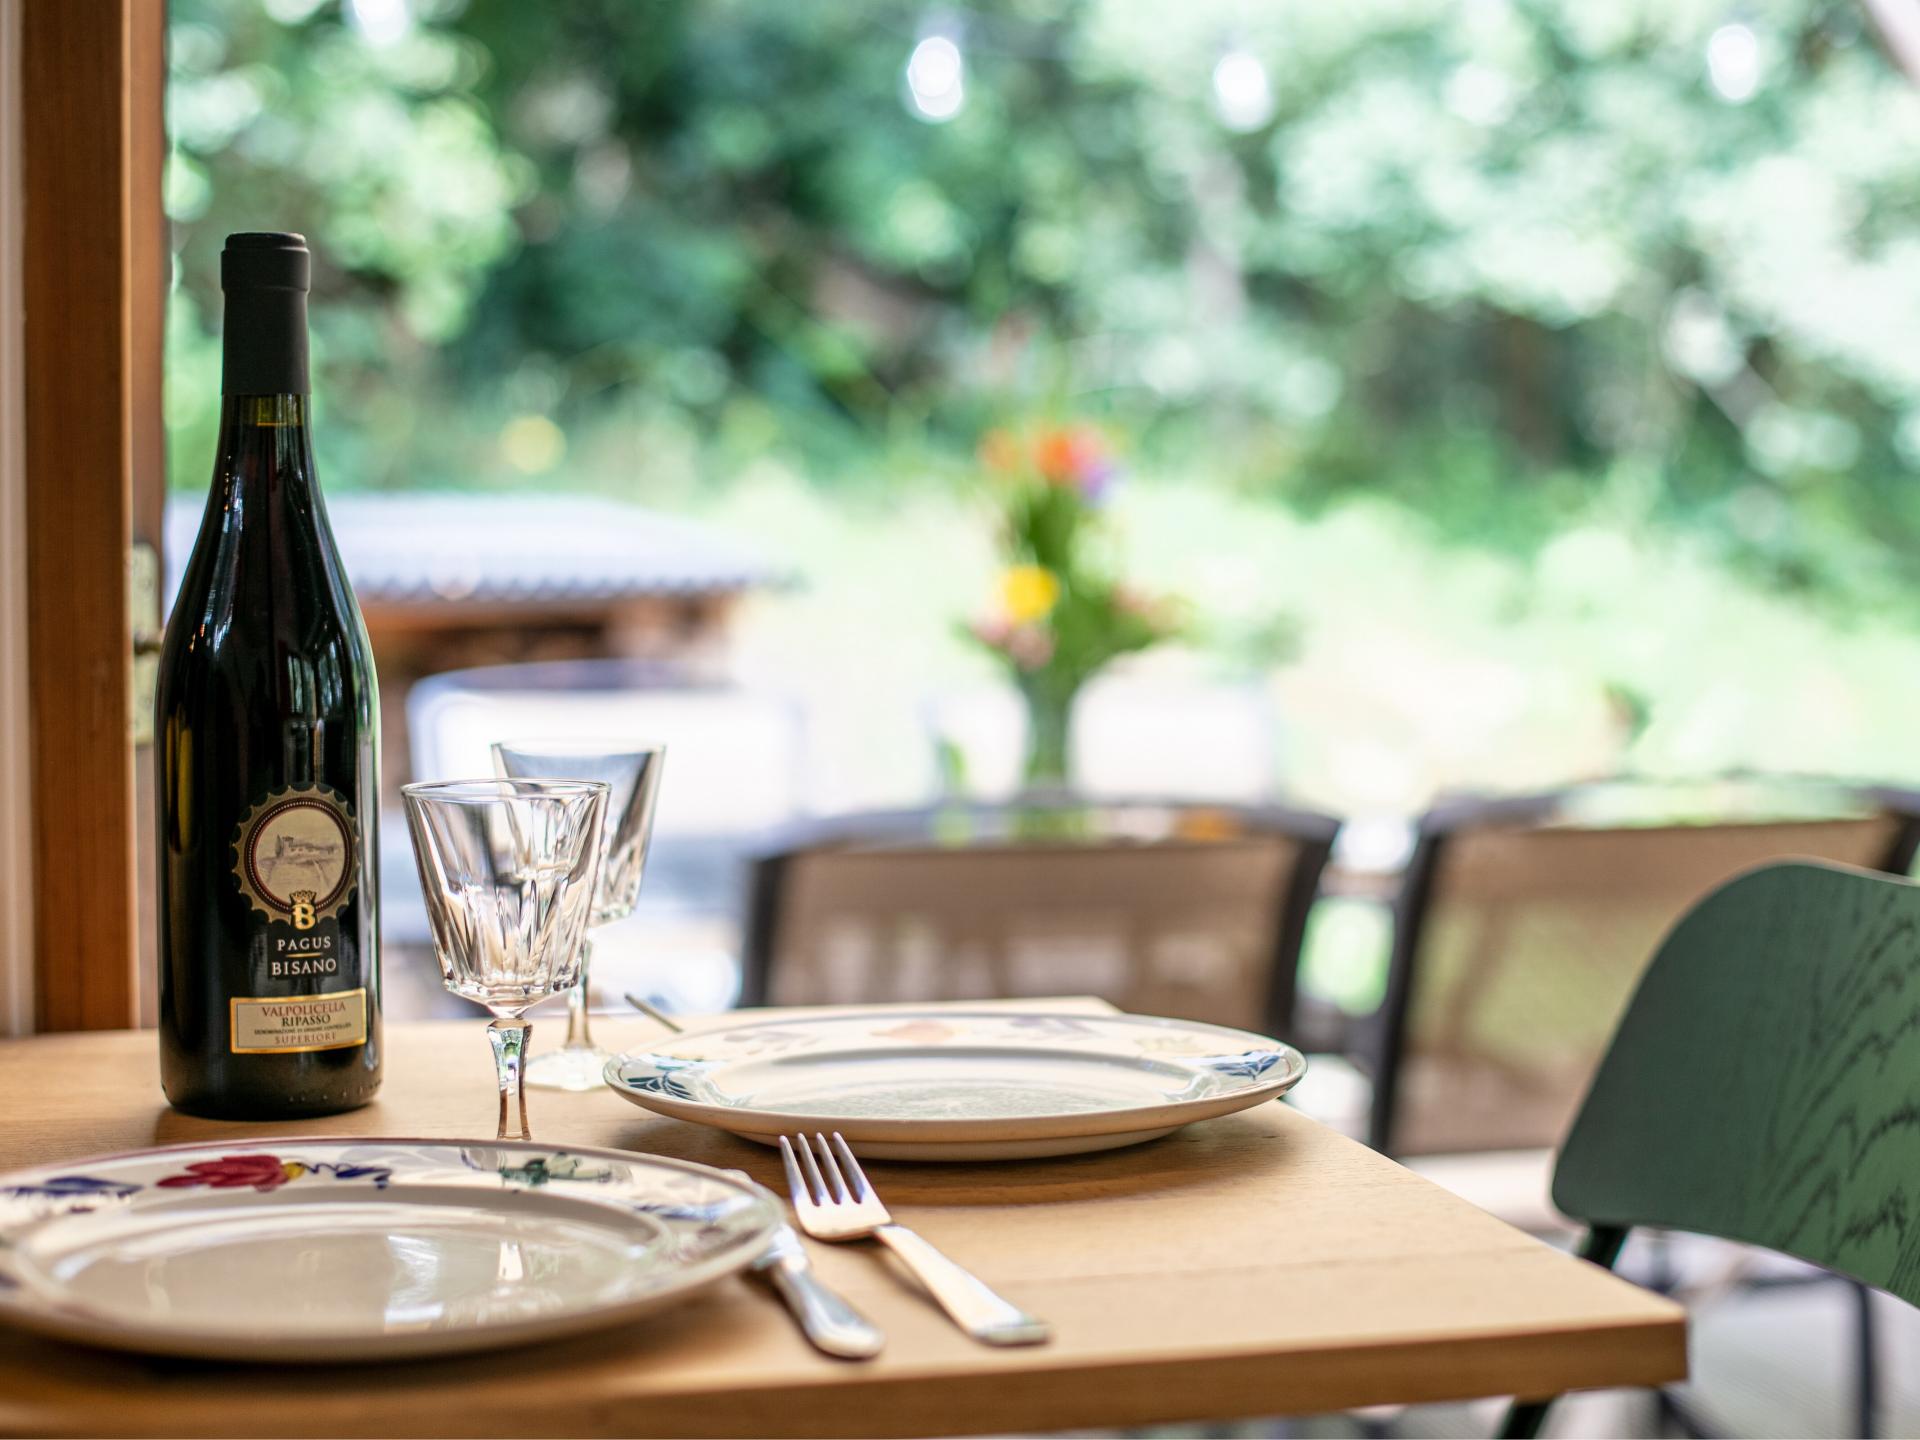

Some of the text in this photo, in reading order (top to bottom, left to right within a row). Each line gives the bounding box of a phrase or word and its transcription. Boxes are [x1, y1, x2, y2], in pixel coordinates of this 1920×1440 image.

[294, 903, 315, 930] B
[277, 936, 331, 951] PAGUS
[271, 958, 337, 976] BISANO
[262, 1001, 346, 1017] VALPOLICELLA
[281, 1014, 331, 1027] RIPASSO
